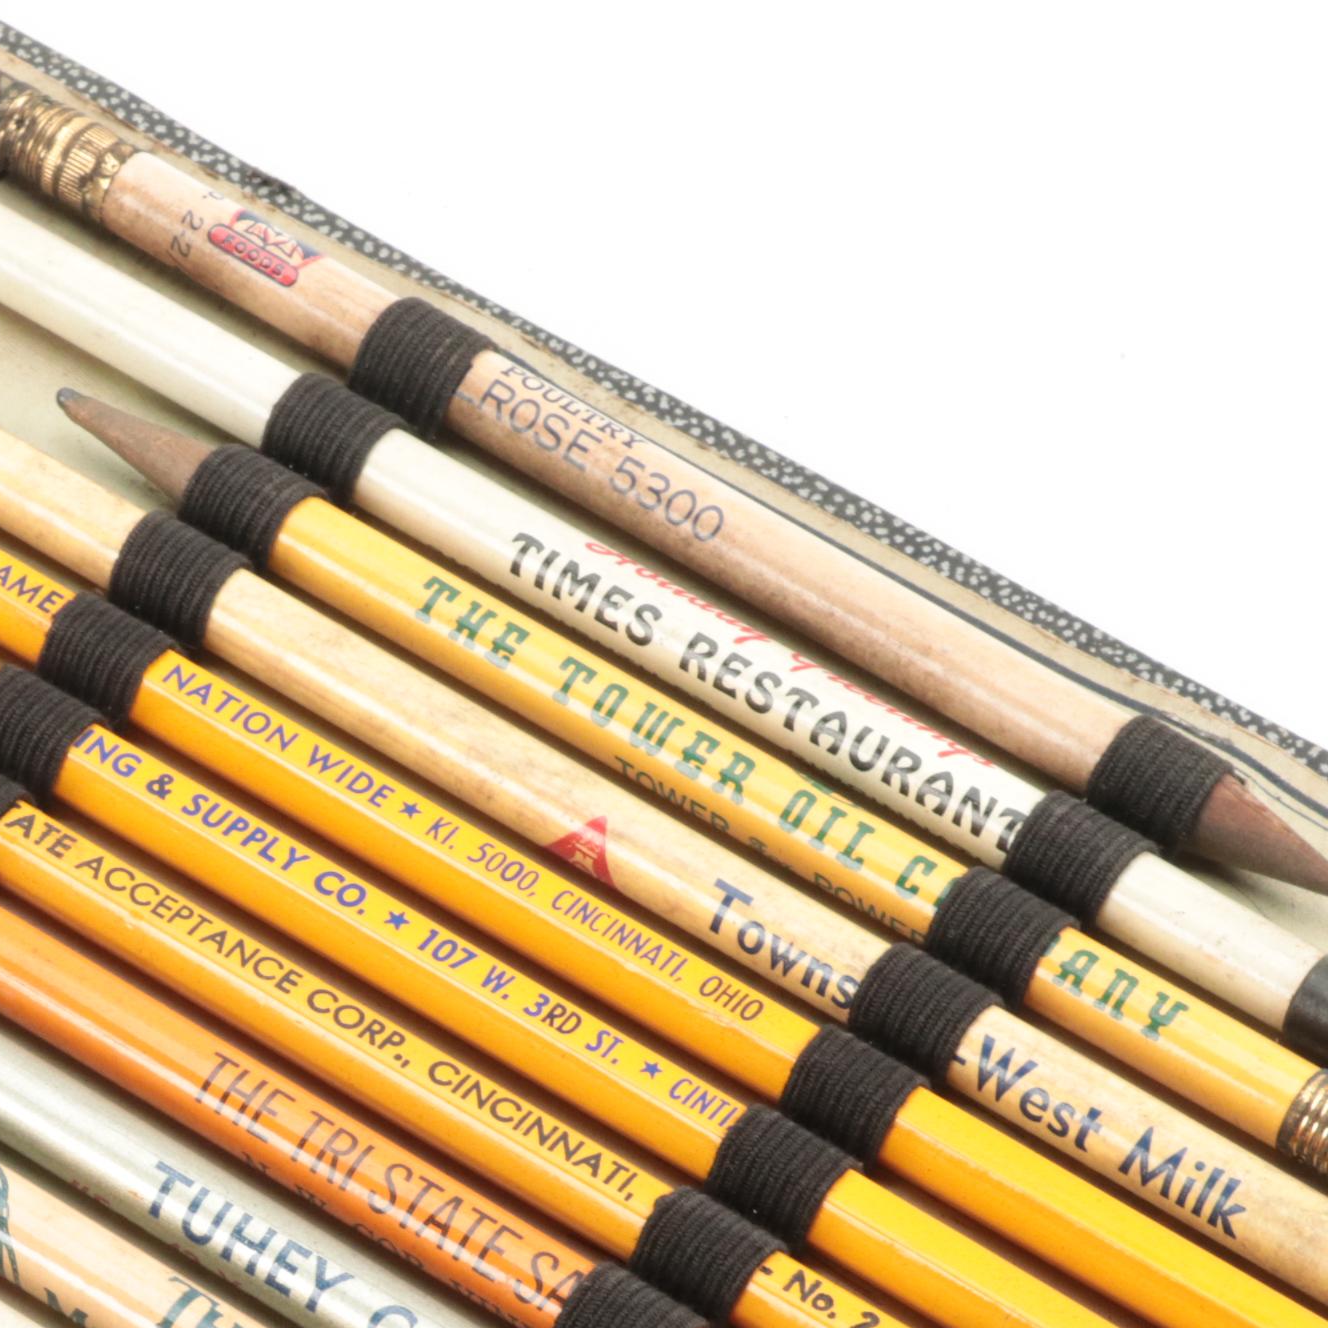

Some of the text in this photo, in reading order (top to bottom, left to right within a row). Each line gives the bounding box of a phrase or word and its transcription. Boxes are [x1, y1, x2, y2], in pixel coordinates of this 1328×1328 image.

[477, 378, 725, 542] ROSE 5300
[500, 364, 648, 450] POULTRY
[161, 664, 299, 752] NATION
[306, 744, 396, 809] WIDE
[467, 841, 541, 899] 5000,
[550, 889, 687, 984] CINCINNATI,
[698, 975, 765, 1022] OHIO
[414, 575, 531, 671] THE
[551, 655, 756, 806] TOWER
[777, 788, 876, 872] OIL
[508, 531, 663, 647] TIMES
[678, 631, 1029, 853] RESTAURANT
[3, 812, 78, 860] ATE
[74, 855, 304, 995] ACCEPTANCE
[427, 1060, 639, 1203] CINCINNATI,
[72, 728, 143, 778] ING
[145, 773, 175, 800] &
[181, 792, 311, 872] SUPPLY
[313, 870, 367, 916] CO.
[416, 928, 478, 971] 107
[480, 965, 516, 1001] W.
[522, 993, 583, 1035] 3RD
[585, 1029, 625, 1065] ST.
[193, 1051, 297, 1144] THE
[290, 1109, 376, 1192] TRI
[367, 1162, 525, 1283] STATE
[709, 877, 860, 1010] Towns
[1118, 1126, 1247, 1239] Milk
[147, 1160, 355, 1314] TUHEY
